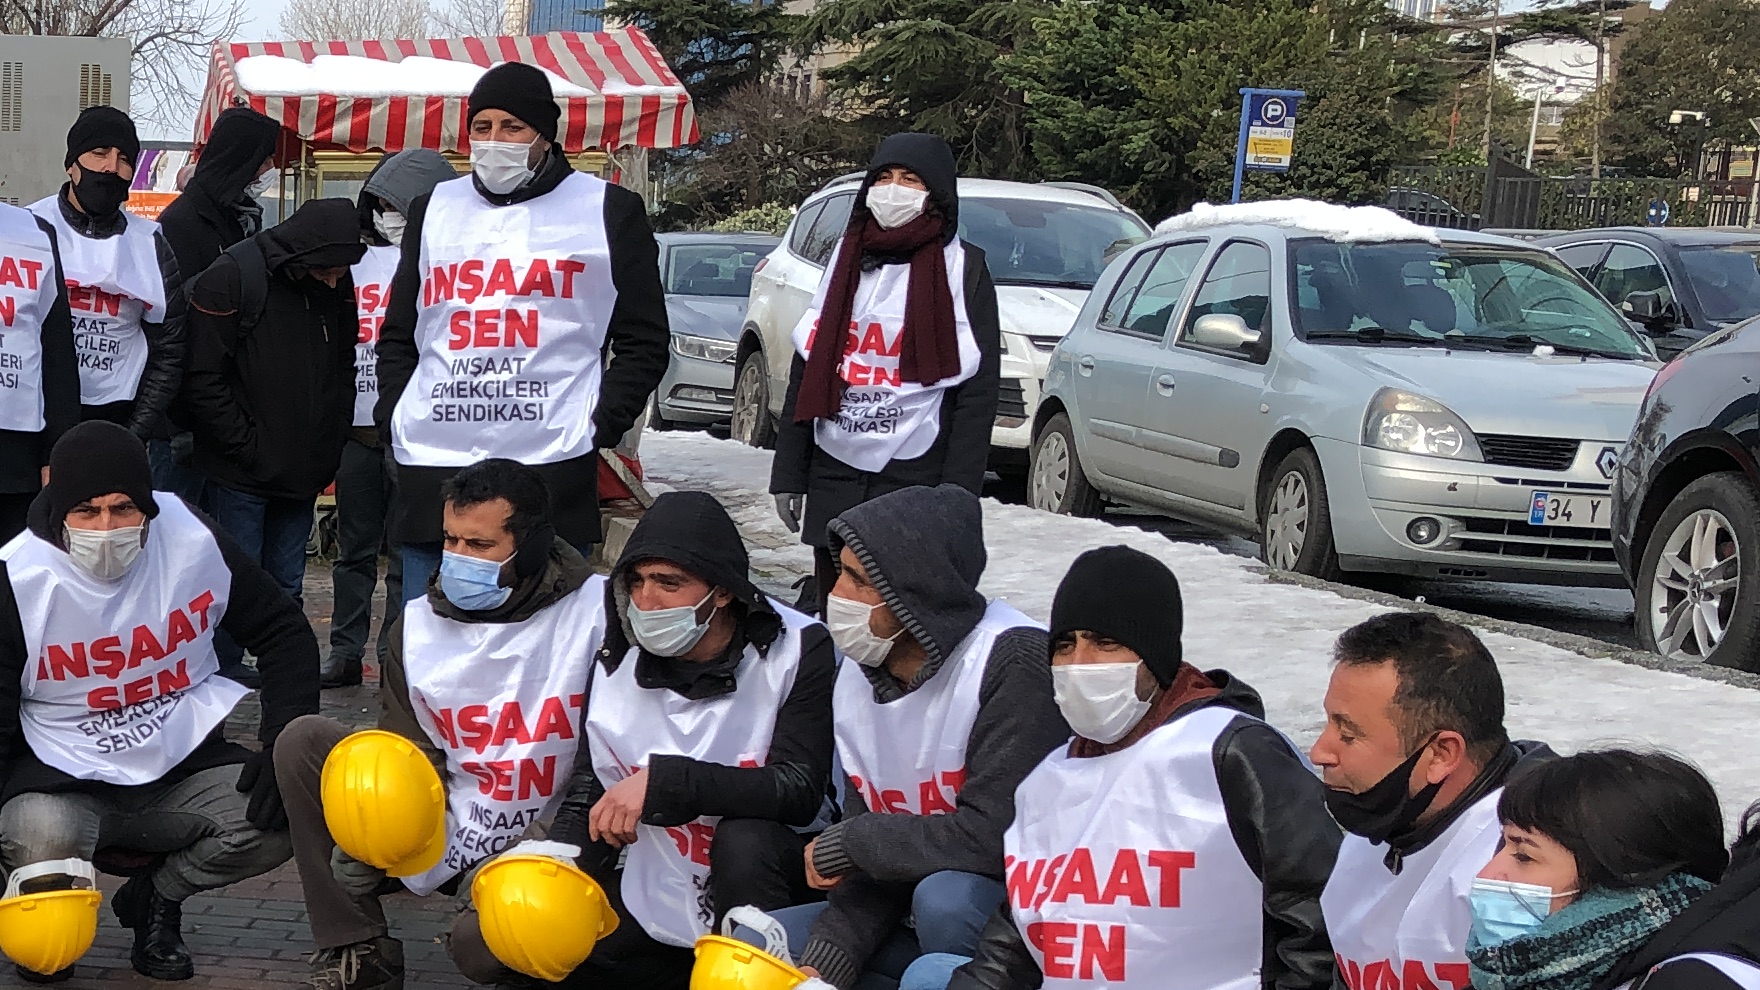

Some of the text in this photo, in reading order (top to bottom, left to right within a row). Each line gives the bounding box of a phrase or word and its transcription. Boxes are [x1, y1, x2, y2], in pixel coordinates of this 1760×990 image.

[424, 258, 586, 307] İNŞAAT
[449, 309, 538, 350] SEN
[451, 357, 526, 377] İNŞAAT
[431, 380, 549, 400] EMEKÇİLERİ
[432, 402, 544, 422] SENDİKASI
[1547, 498, 1572, 521] 34
[1590, 499, 1601, 523] Y
[87, 658, 191, 712] SEN
[461, 755, 556, 801] SEN
